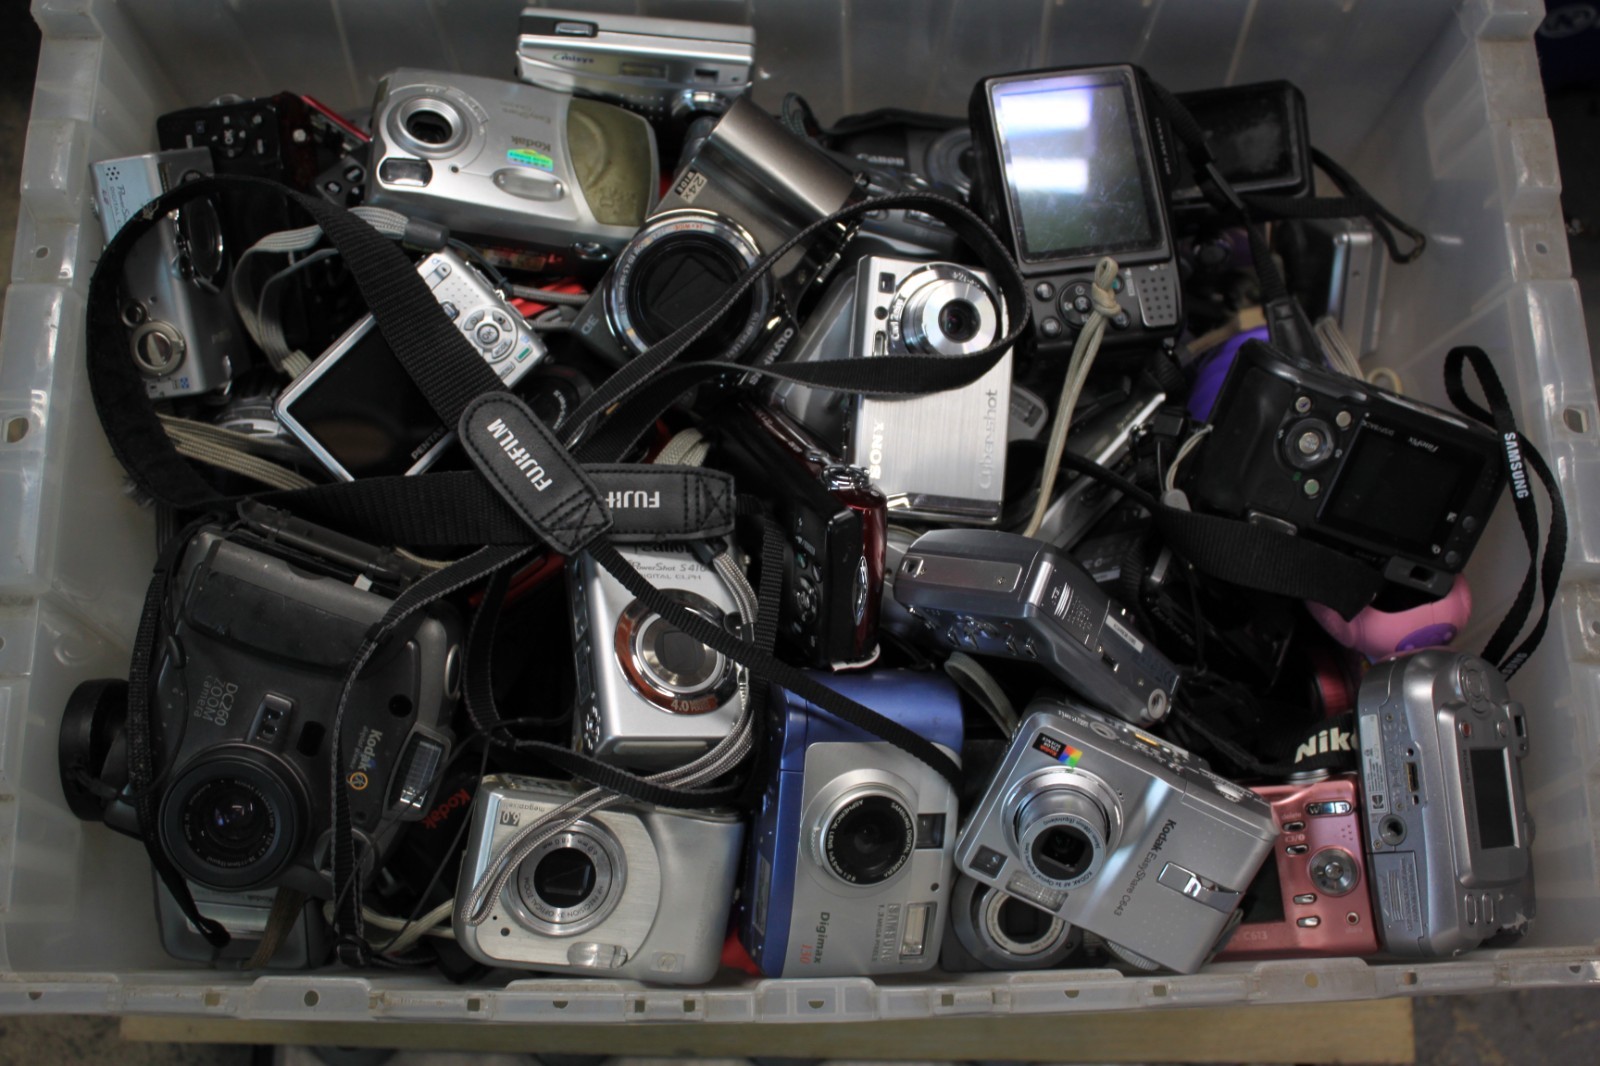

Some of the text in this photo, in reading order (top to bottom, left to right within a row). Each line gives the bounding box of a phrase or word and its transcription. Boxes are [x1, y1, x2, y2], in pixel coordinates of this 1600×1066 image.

[511, 135, 550, 151] Kodak
[676, 171, 695, 195] WIDE
[684, 174, 706, 201] 24x
[482, 329, 494, 341] OK
[750, 327, 794, 385] OLYMS
[486, 418, 553, 492] FUJIFILM
[868, 421, 886, 481] SONY
[1408, 436, 1439, 453] FinePix
[1504, 431, 1530, 499] SAMSUNG
[605, 490, 661, 509] FUJIF
[631, 559, 676, 572] PowerShot
[192, 674, 214, 718] camera
[201, 676, 227, 723] ZOOM
[214, 681, 239, 727] DC260
[670, 699, 690, 713] 4.0
[359, 728, 383, 772] Kodak
[1295, 727, 1359, 763] Nik
[424, 788, 471, 829] Kodak
[501, 811, 520, 825] 6.0
[831, 799, 864, 830] ASPHERICAL
[1310, 803, 1320, 814] W
[827, 831, 835, 849] LENS
[883, 801, 912, 878] SAMSUNG DIGITAL CAMERA
[1074, 871, 1093, 886] KODAK
[1112, 818, 1177, 918] Kodak EasyShare C643
[523, 876, 535, 899] ZOOM
[530, 896, 555, 917] OPTICAL
[813, 911, 830, 966] Digimax
[873, 919, 882, 937] MEGA
[881, 903, 901, 964] SAMSUNG
[870, 937, 880, 962] PIXELS
